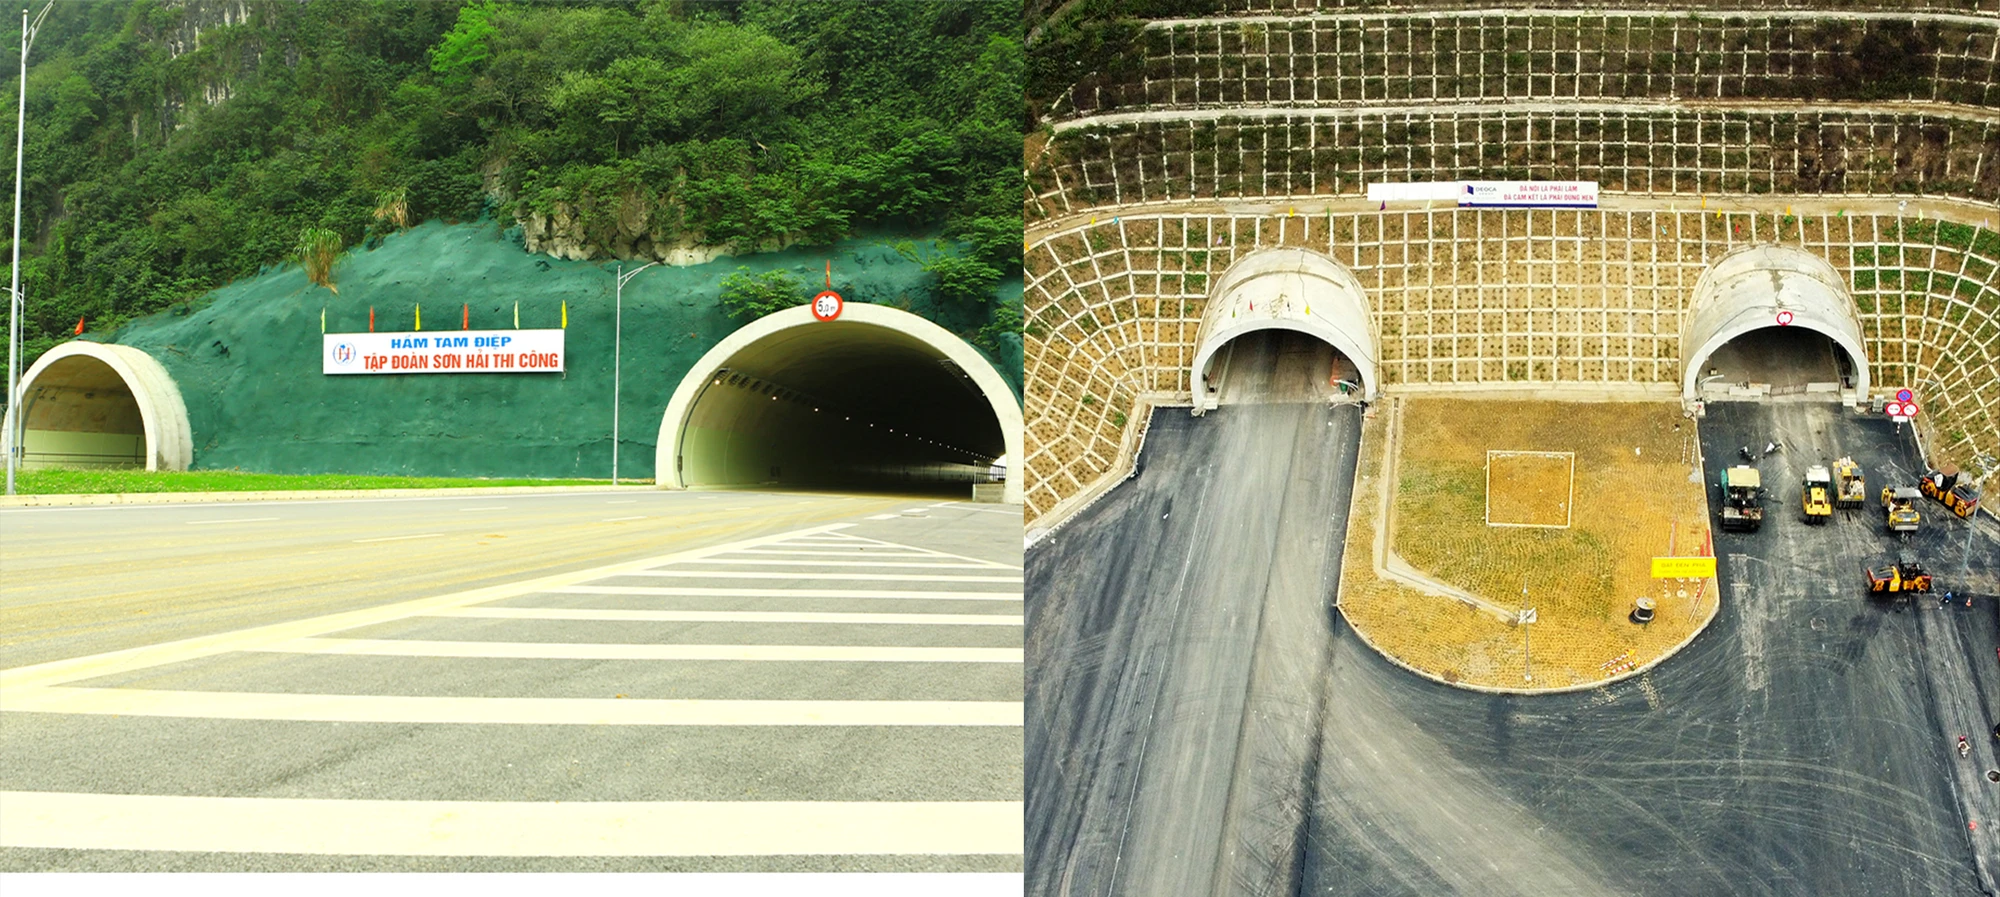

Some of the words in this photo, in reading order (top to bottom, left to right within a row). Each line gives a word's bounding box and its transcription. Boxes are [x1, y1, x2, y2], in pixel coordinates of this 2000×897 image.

[433, 336, 469, 349] TAM
[473, 334, 512, 350] ĐIỆP
[433, 352, 461, 369] SƠN
[466, 348, 489, 368] HẢI
[493, 353, 514, 368] THI
[519, 350, 558, 368] CÔNG
